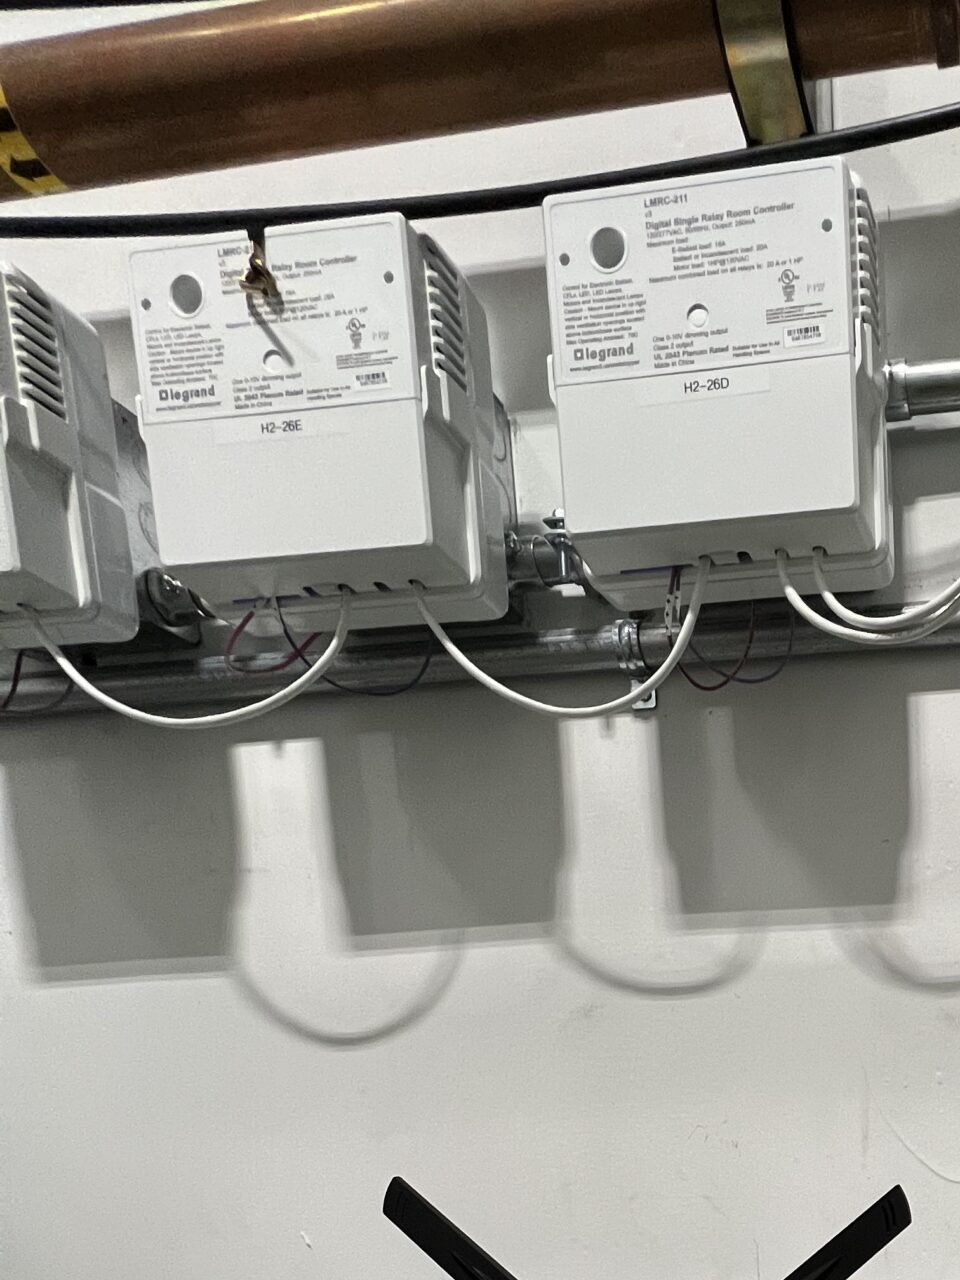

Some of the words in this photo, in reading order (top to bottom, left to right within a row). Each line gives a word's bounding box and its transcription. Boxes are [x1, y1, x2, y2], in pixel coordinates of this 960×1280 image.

[644, 193, 687, 208] LMRC-211
[646, 219, 672, 230] Digital
[674, 216, 699, 227] Single
[701, 212, 724, 222] Relay
[726, 210, 751, 218] Room
[753, 203, 795, 215] Controller
[586, 342, 634, 362] legrand
[682, 350, 707, 358] Plenum
[170, 384, 215, 402] legrand
[684, 377, 729, 393] H2-26D
[261, 419, 302, 434] H2-26E
